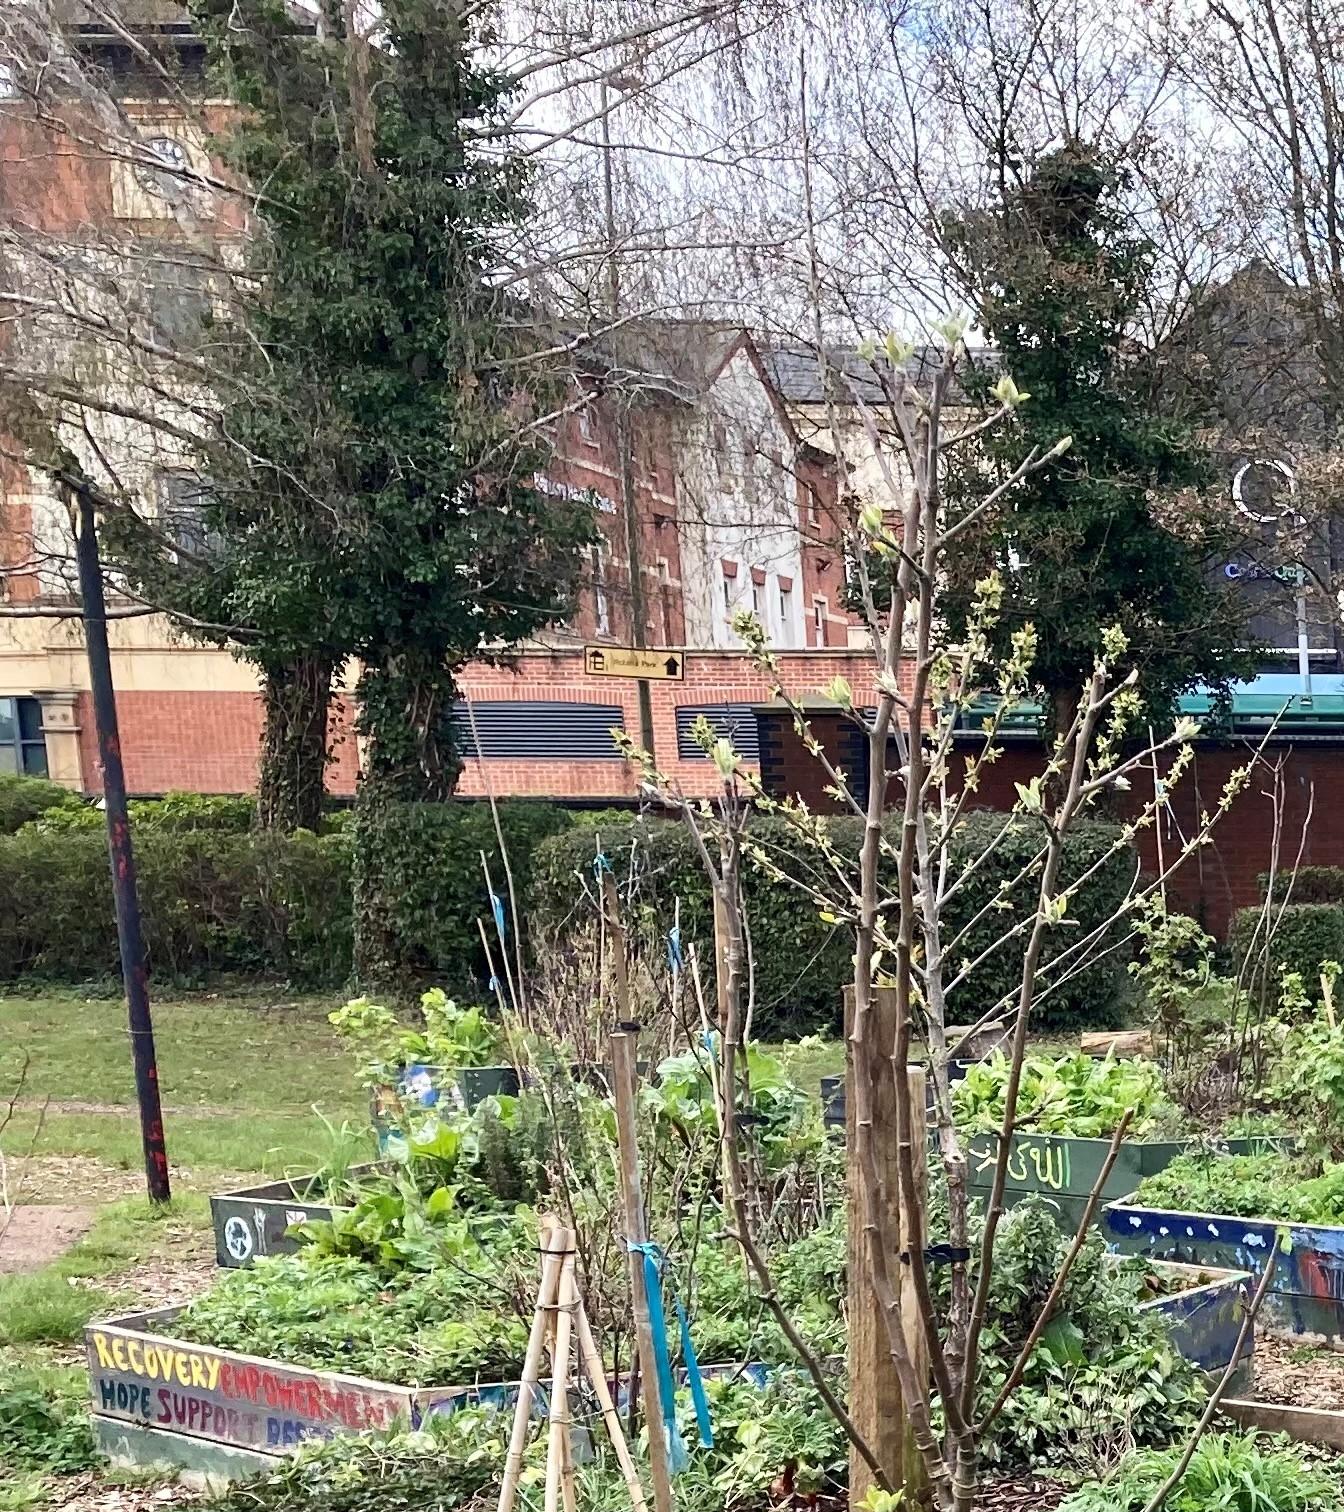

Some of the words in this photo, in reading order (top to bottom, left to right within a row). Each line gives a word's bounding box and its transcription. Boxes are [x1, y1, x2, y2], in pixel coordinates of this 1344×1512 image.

[93, 1332, 221, 1391] RECOVERY
[100, 1378, 150, 1420] HOPE
[156, 1388, 259, 1445] SUPPORT
